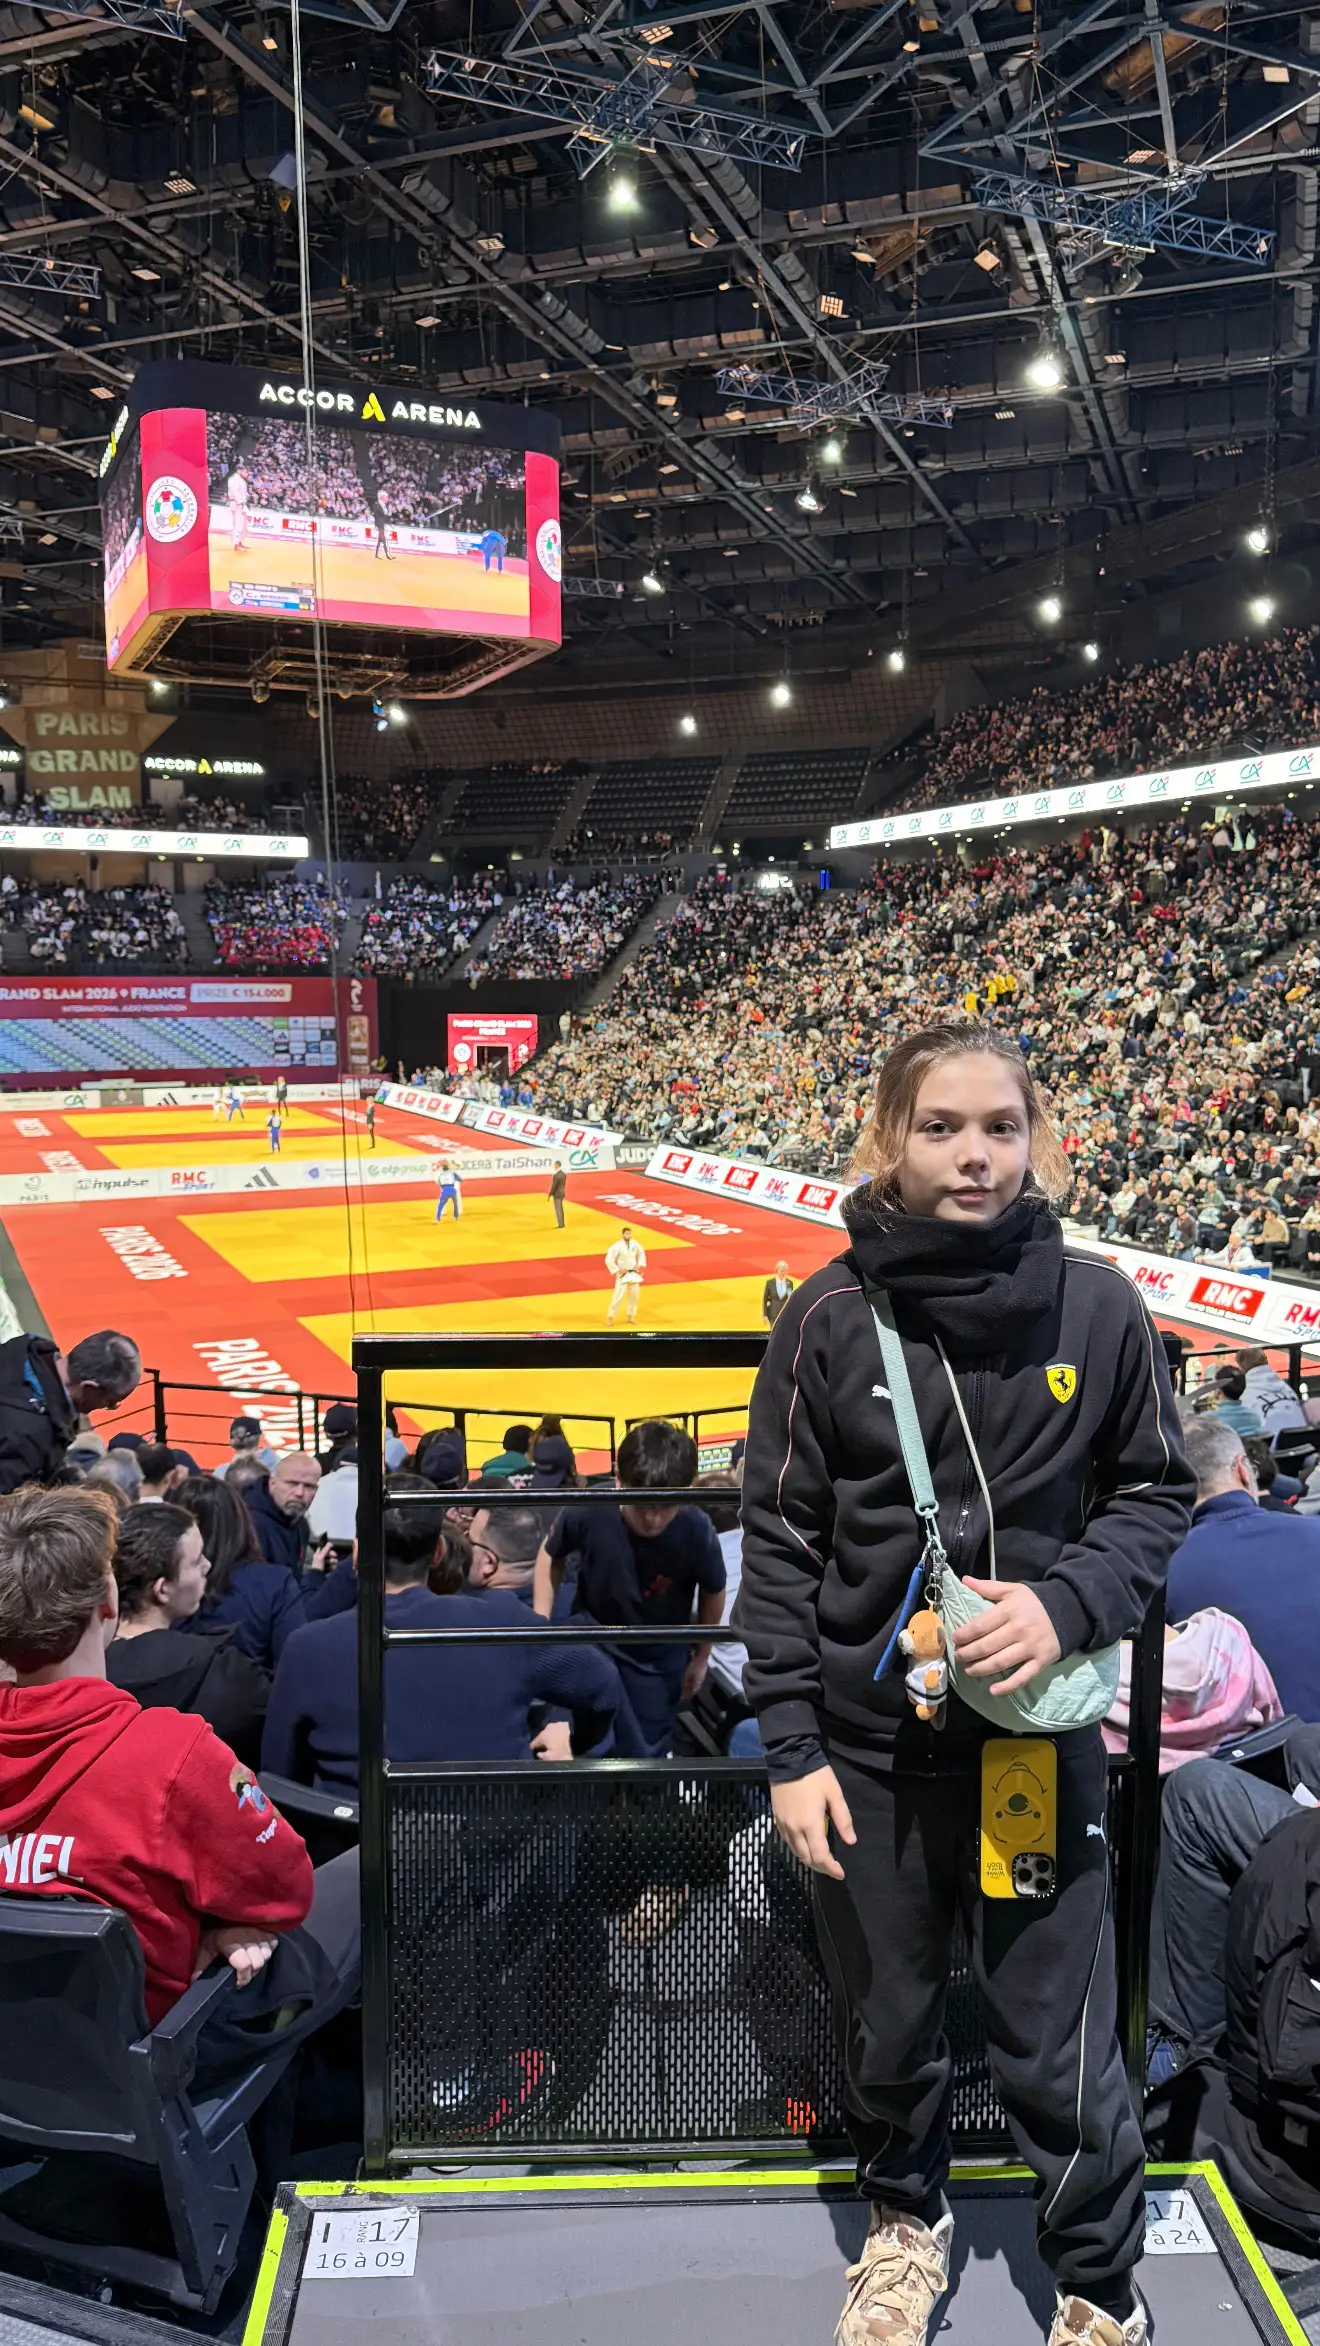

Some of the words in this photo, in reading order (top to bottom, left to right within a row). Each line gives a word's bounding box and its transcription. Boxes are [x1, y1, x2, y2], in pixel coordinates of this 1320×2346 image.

[259, 383, 354, 412] ACCOR
[391, 401, 482, 429] ARENA
[35, 711, 130, 736] PARIS
[29, 750, 140, 773] GRAND
[145, 756, 197, 772] ACCOR
[213, 760, 265, 775] ARENA
[50, 786, 132, 811] SLAM
[43, 987, 83, 1000] SLAM
[86, 987, 117, 999] 2026
[130, 986, 186, 1000] FRANCE
[172, 1171, 207, 1185] RMC
[765, 1178, 790, 1195] RMC
[1133, 1266, 1175, 1291] RMC
[1202, 1281, 1254, 1311] RMC
[1284, 1303, 1320, 1329] RM
[192, 1338, 301, 1399] PARIS
[1147, 2200, 1185, 2221] 17
[357, 2221, 369, 2243] RANG
[369, 2218, 411, 2243] 17
[1151, 2229, 1166, 2245] à
[1169, 2229, 1202, 2245] 24
[316, 2252, 347, 2269] 16
[354, 2251, 367, 2269] à
[375, 2251, 405, 2268] 09
